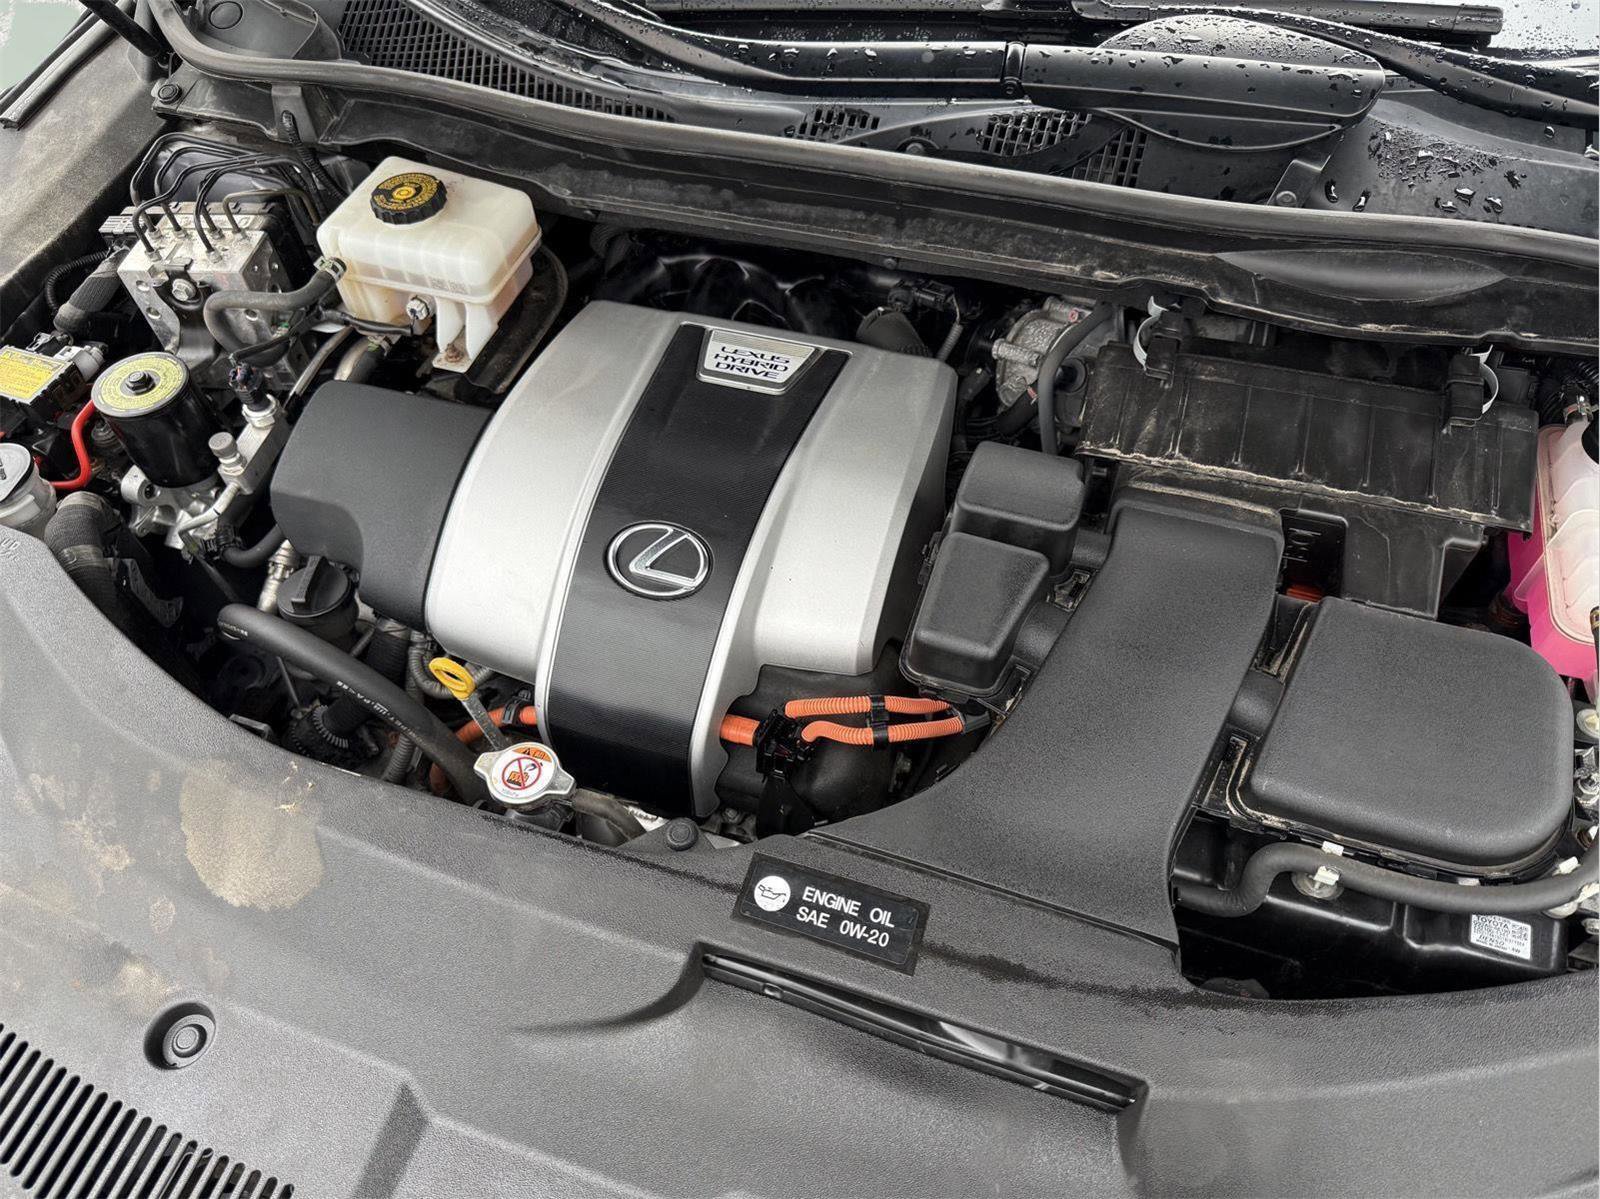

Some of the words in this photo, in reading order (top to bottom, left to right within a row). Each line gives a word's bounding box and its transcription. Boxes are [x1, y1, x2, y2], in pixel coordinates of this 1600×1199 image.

[714, 353, 789, 372] HYBRID
[721, 346, 790, 364] LEXUS
[715, 362, 780, 379] DRIVE
[802, 886, 861, 917] ENGINE
[869, 907, 895, 928] OIL
[796, 906, 830, 928] SAE
[839, 920, 889, 947] 0W-20
[1476, 915, 1509, 929] TOYOTA
